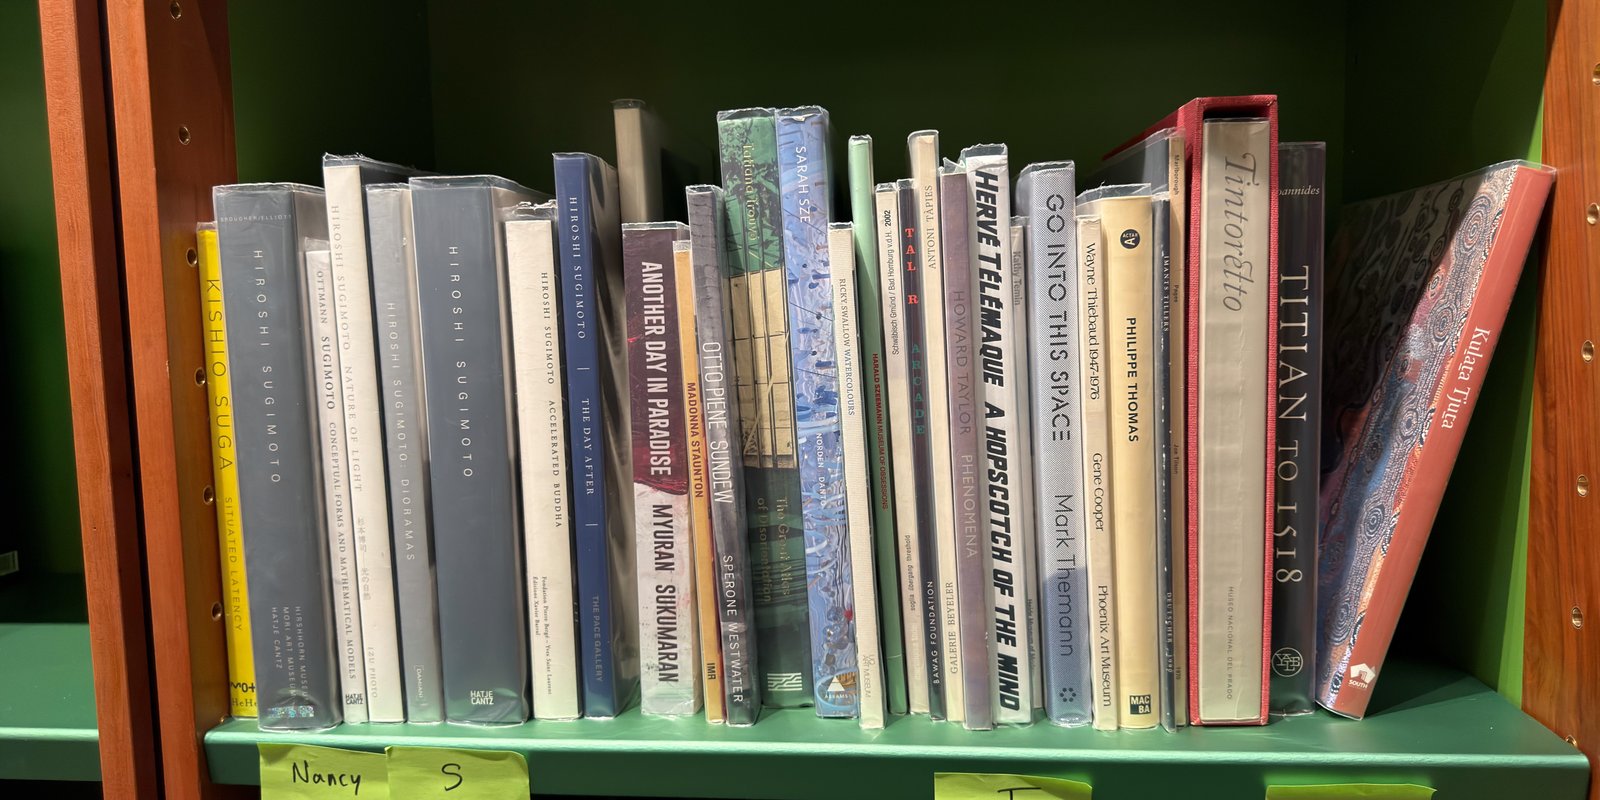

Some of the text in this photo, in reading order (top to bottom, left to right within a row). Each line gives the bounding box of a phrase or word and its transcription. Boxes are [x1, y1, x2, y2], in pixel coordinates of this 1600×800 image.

[742, 143, 755, 193] Tatiana
[796, 146, 811, 223] SARAH SZE
[883, 209, 892, 227] 2002
[886, 249, 895, 277] Homburg
[924, 185, 937, 269] ANTONI TÀPIES
[1222, 152, 1260, 311] Tintoretto
[887, 278, 895, 291] Bad
[905, 228, 919, 305] TAL R
[1011, 251, 1023, 306] Kathy Temin
[331, 205, 363, 492] HIROSHI SUGIMOTO NATURE OF LIGHT
[449, 246, 473, 477] HIROSHI SUGIMOTO
[569, 197, 595, 495] HIROSHI SUGIMOTO THE DAY AFTER
[839, 278, 855, 416] RICKY SWALLOW WATERCOLOURS
[1046, 194, 1071, 441] GO INTO THIS SPACE
[1084, 242, 1100, 400] Wayne Thiebaud 1947-1976
[206, 279, 233, 470] KISHIO SUGA
[253, 250, 281, 482] HIROSHI SUGIMOTO
[541, 272, 562, 528] HIROSHI SUGIMOTO ACCELERATED BUDDHA
[641, 261, 671, 475] ANOTHER DAY IN PARADISE
[912, 344, 925, 434] ARCADE
[1125, 317, 1139, 442] PHILIPPE THOMAS
[387, 303, 400, 369] HIROSHI
[401, 479, 415, 561] DIORAMAS
[687, 382, 703, 498] MADONNA STAUNTON
[702, 342, 732, 502] OTTO PIENE SUNDEW
[816, 433, 824, 468] NORDEN
[872, 353, 889, 509] HARALD SZEEMANN MUSEUM OF OBSESSIONS
[953, 291, 978, 558] HOWARD TAYLOR PHENOMENA
[975, 170, 1020, 712] HERVÉ TÉLÉMAQUE A HOPSCOTCH OF THE MIND
[1273, 265, 1309, 582] TITIAN TO 1518
[316, 270, 357, 679] OTTMANN SUGIMOTO CONCEPTUAL FORMS AND MATHEMATICAL MODELS
[756, 497, 769, 511] of
[776, 496, 788, 519] The
[1092, 453, 1105, 532] Gene Cooper
[224, 497, 242, 631] SITUATED LATENCY
[653, 504, 679, 682] MYURAN SUKUMARAN
[1054, 495, 1076, 656] Mark Themann
[1227, 586, 1235, 612] MUSEO
[271, 607, 282, 669] HATJE CANTZ
[282, 606, 291, 631] MORI
[285, 635, 293, 652] ART
[592, 596, 603, 682] THE PACE GALLERY
[723, 555, 743, 702] SPERONE WESTWATER
[926, 581, 940, 684] BAWAG FOUNDATION
[945, 582, 958, 674] GALERIE BEYELER
[1098, 585, 1112, 706] Phoenix Art Museum
[369, 667, 378, 698] PHOTO
[470, 690, 493, 698] HATJE
[471, 697, 494, 705] CANTZ
[707, 662, 716, 679] IMR
[1130, 696, 1150, 705] MAC
[1138, 705, 1150, 713] BA
[1348, 679, 1368, 689] SOUTH
[292, 760, 361, 795] Nancy
[441, 763, 463, 791] S
